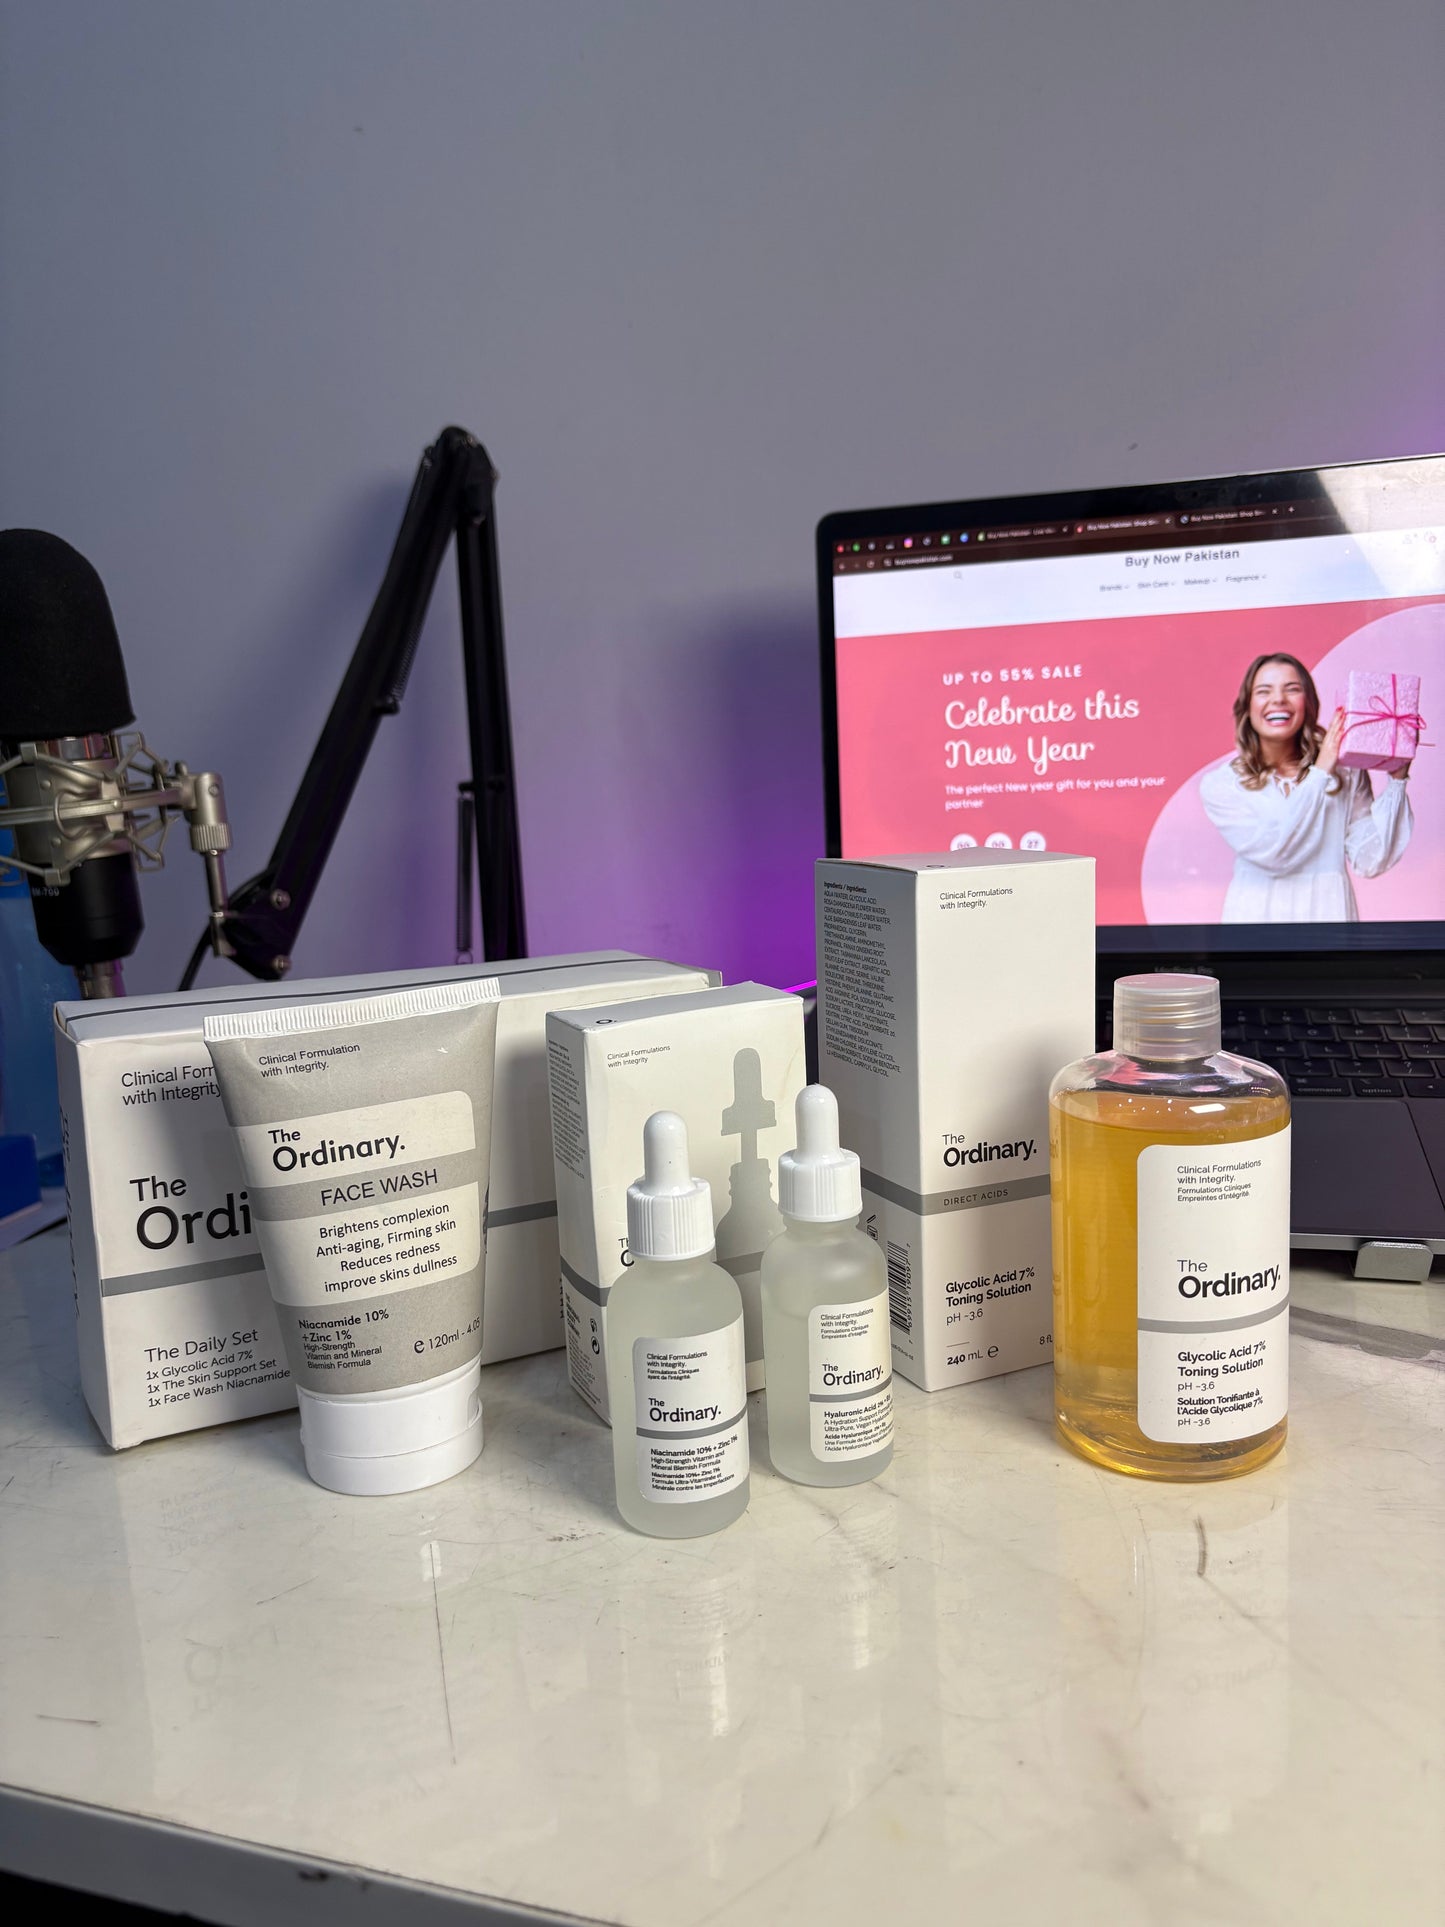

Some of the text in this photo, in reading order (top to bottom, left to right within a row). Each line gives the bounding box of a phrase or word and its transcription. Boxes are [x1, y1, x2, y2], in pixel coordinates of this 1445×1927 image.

[1125, 549, 1240, 568] Buy Now Pakistan
[943, 664, 1082, 685] UP TO 55% SALE
[945, 689, 1140, 730] Celebrate this
[945, 736, 1095, 776] New Year
[945, 776, 1166, 796] The perfect New year gift for you and your
[945, 799, 984, 812] partner
[940, 887, 1013, 901] Clinical Formulations
[940, 898, 987, 910] with Integrity.
[258, 1043, 360, 1066] Clinical Formulation
[607, 1045, 670, 1060] Clinical Formulations
[121, 1067, 178, 1087] Clinical
[261, 1060, 329, 1078] with Integrity.
[122, 1089, 157, 1105] with
[268, 1129, 301, 1144] The
[942, 1134, 965, 1145] The
[273, 1135, 405, 1172] Ordinary.
[944, 1140, 1036, 1167] Ordinary.
[1177, 1159, 1261, 1174] Clinical Formulations
[321, 1168, 438, 1206] FACE WASH
[1177, 1174, 1235, 1184] with Integrity.
[129, 1176, 187, 1201] The
[1224, 1183, 1251, 1192] Cliniques
[944, 1189, 1008, 1206] DIRECT ACIDS
[1178, 1195, 1217, 1203] Empreintes
[319, 1203, 450, 1239] Brightens complexion
[316, 1219, 456, 1257] Anti-aging, Firming skin
[341, 1241, 441, 1272] Reduces redness
[325, 1254, 457, 1292] improve skins dullness
[1177, 1259, 1208, 1272] The
[946, 1267, 1035, 1295] Glycolic Acid 7%
[1178, 1264, 1281, 1298] Ordinary.
[946, 1282, 1031, 1308] Toning Solution
[298, 1308, 389, 1329] Niacnamide 10%
[842, 1308, 873, 1319] Formulations
[946, 1312, 961, 1326] pH
[336, 1329, 352, 1340] 1%
[429, 1329, 459, 1349] 120ml
[1039, 1336, 1045, 1345] 8
[144, 1329, 258, 1362] The Daily Set
[304, 1341, 355, 1352] High-Strength
[306, 1346, 382, 1360] Vitamin and Mineral
[1178, 1340, 1266, 1364] Glycolic Acid 7%
[669, 1351, 707, 1360] Formulations
[947, 1350, 983, 1365] 240 mL
[146, 1350, 253, 1380] 1x Glycolic Acid 7%
[307, 1358, 371, 1370] Blemish Formula
[1178, 1358, 1263, 1378] Toning Solution
[148, 1359, 277, 1394] 1x The Skin Support Set
[823, 1365, 883, 1386] Ordinary.
[148, 1369, 291, 1408] 1x Face Wash Niacnamide
[1177, 1382, 1192, 1392] pH
[648, 1398, 665, 1406] The
[1177, 1390, 1254, 1405] Solution Tonifiante
[1177, 1396, 1263, 1415] l'Acide Glycolique 7%
[650, 1405, 721, 1422] Ordinary.
[824, 1404, 876, 1419] Hyaluronic Acid
[830, 1411, 877, 1426] Hydration Support
[856, 1420, 871, 1428] Vegan
[1178, 1419, 1191, 1427] pH
[841, 1429, 873, 1439] Hyaluronique
[696, 1446, 712, 1454] 10%
[718, 1440, 730, 1450] Zinc
[651, 1450, 725, 1465] High-Strength Vitamin and
[699, 1459, 721, 1468] Formula
